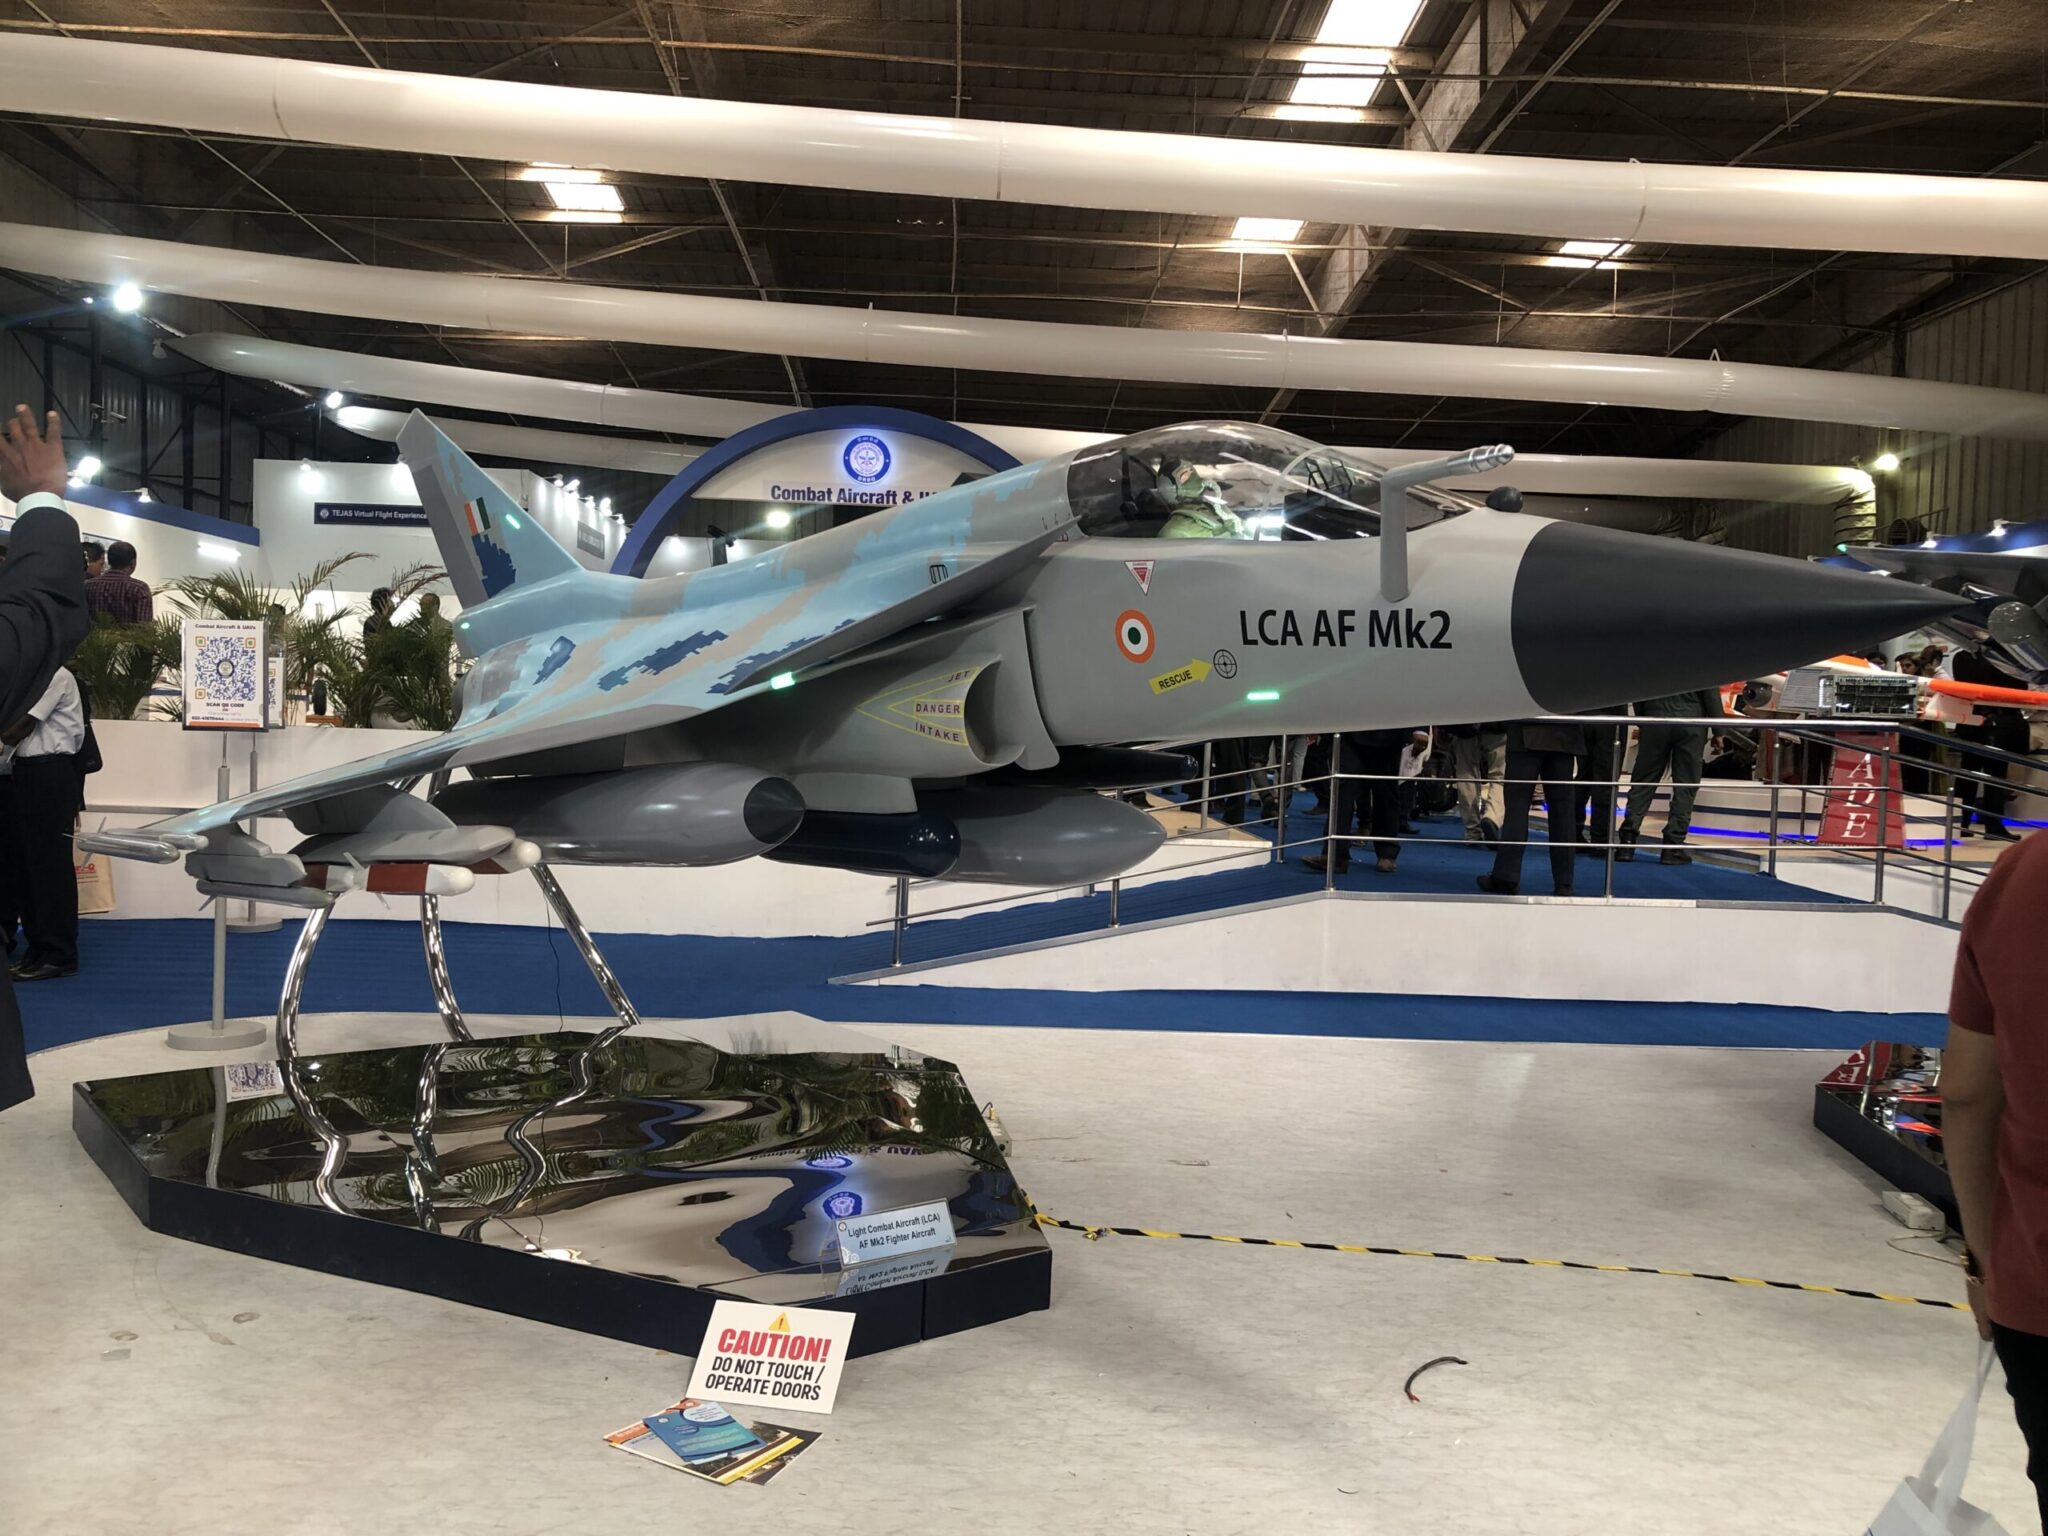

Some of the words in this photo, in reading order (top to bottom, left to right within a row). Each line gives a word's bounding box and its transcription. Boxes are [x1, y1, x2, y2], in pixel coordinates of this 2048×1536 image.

[771, 484, 833, 501] Combat
[837, 487, 898, 505] Aircraft
[902, 490, 915, 504] &
[332, 509, 353, 517] TEJAS
[354, 509, 374, 518] Virtual
[375, 509, 393, 519] Flight
[394, 511, 427, 520] Experience
[1239, 609, 1304, 646] LCA
[1313, 609, 1356, 647] AF
[1368, 608, 1453, 649] Mk2
[948, 670, 970, 683] JET
[1158, 669, 1193, 690] RESCUE
[916, 703, 960, 714] DANGER
[915, 721, 960, 742] INTAKE
[848, 1227, 867, 1238] Light
[867, 1221, 894, 1234] Combat
[895, 1216, 920, 1228] Aircraft
[921, 1212, 941, 1226] (LCA)
[859, 1240, 869, 1249] AF
[870, 1237, 885, 1247] Mk2
[886, 1233, 910, 1245] Fighter
[911, 1227, 936, 1239] Aircraft
[717, 1328, 832, 1363] CAUTION!
[711, 1356, 733, 1372] DO
[734, 1358, 764, 1375] NOT
[767, 1361, 814, 1381] TOUCH
[814, 1365, 826, 1384] /
[705, 1374, 770, 1395] OPERATE
[771, 1381, 822, 1401] DOORS
